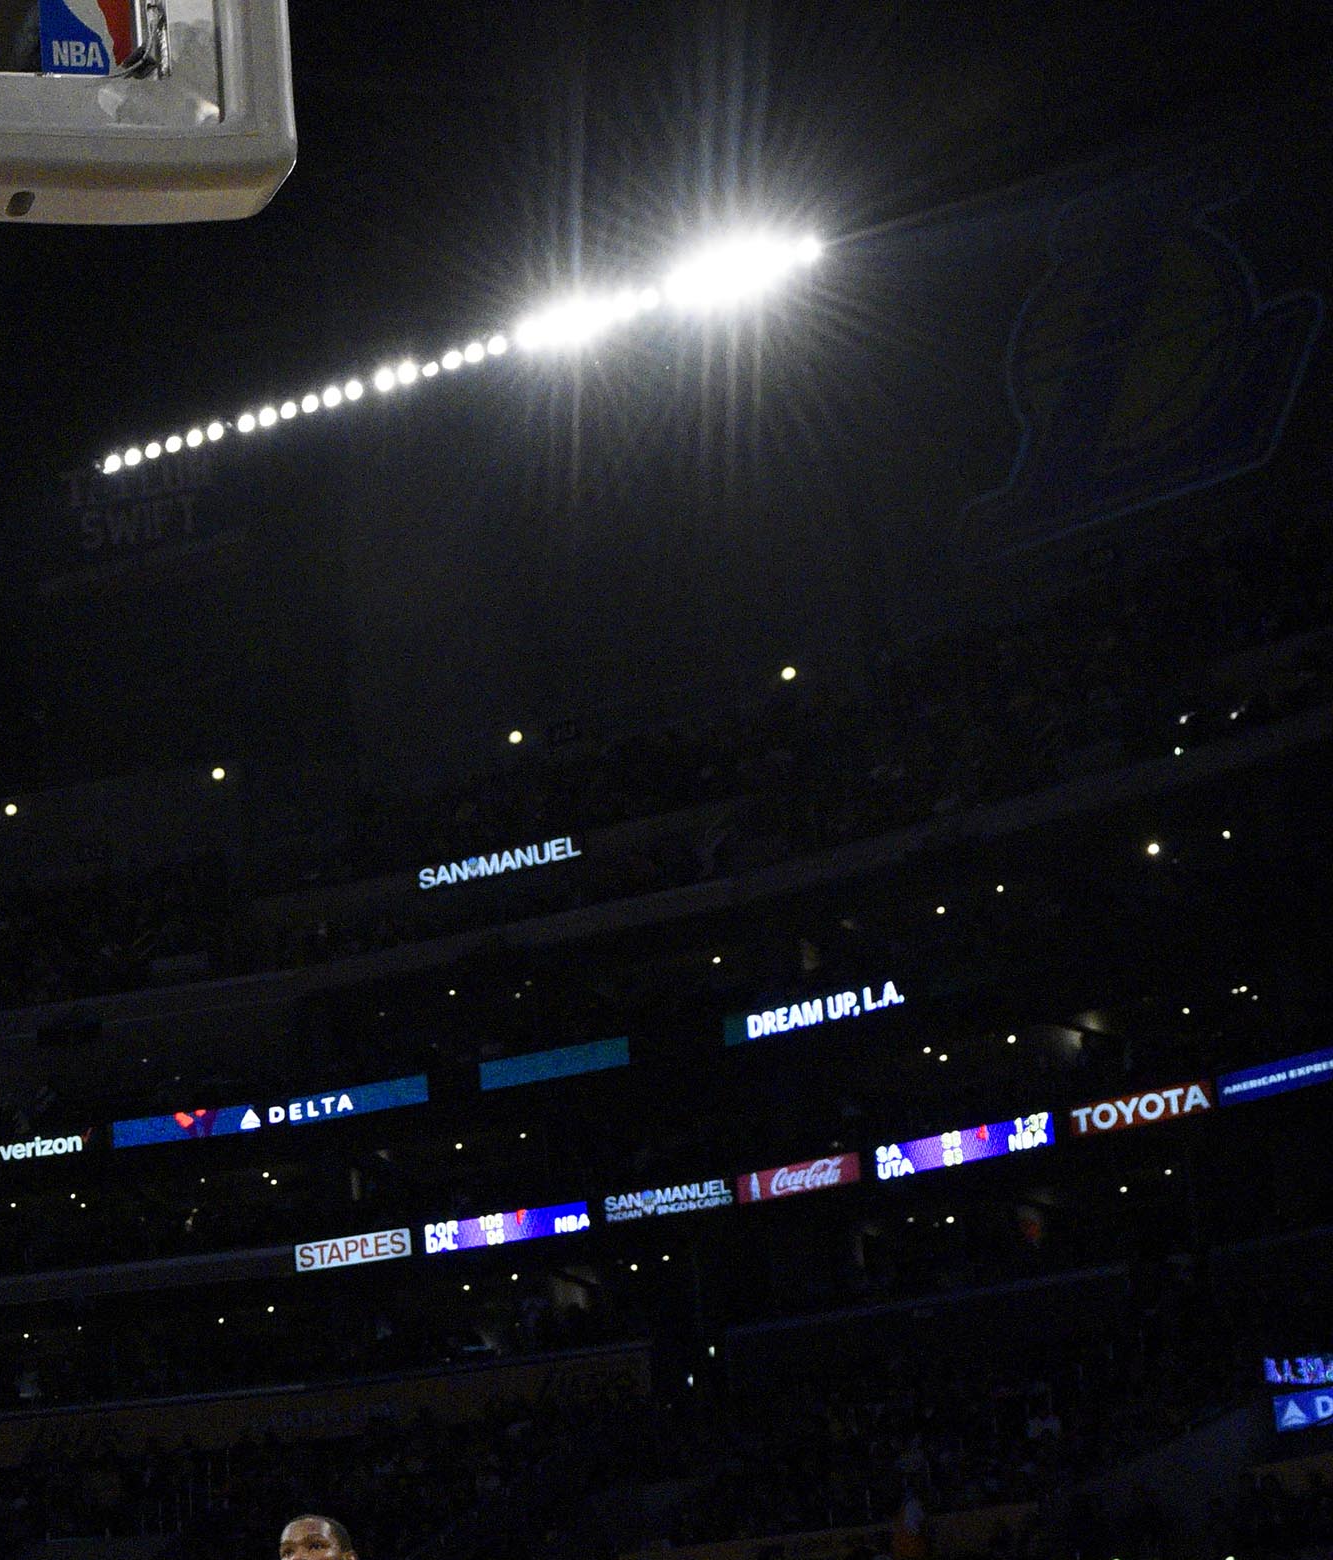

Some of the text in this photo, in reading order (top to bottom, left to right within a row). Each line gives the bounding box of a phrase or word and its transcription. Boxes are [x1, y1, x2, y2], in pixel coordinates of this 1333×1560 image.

[52, 40, 105, 67] NBA
[418, 837, 582, 889] SAN MANUEL
[746, 980, 906, 1040] DREAM UP, L.A.
[1222, 1070, 1288, 1096] AMERICAN
[268, 1093, 354, 1124] DELTA
[1071, 1083, 1211, 1135] TOYOTA
[0, 1133, 84, 1161] verizon
[876, 1143, 903, 1163] SA
[877, 1158, 915, 1180] UTA
[604, 1178, 732, 1213] SAN MANUEL
[554, 1213, 591, 1234] NBA
[298, 1231, 407, 1269] STAPLES
